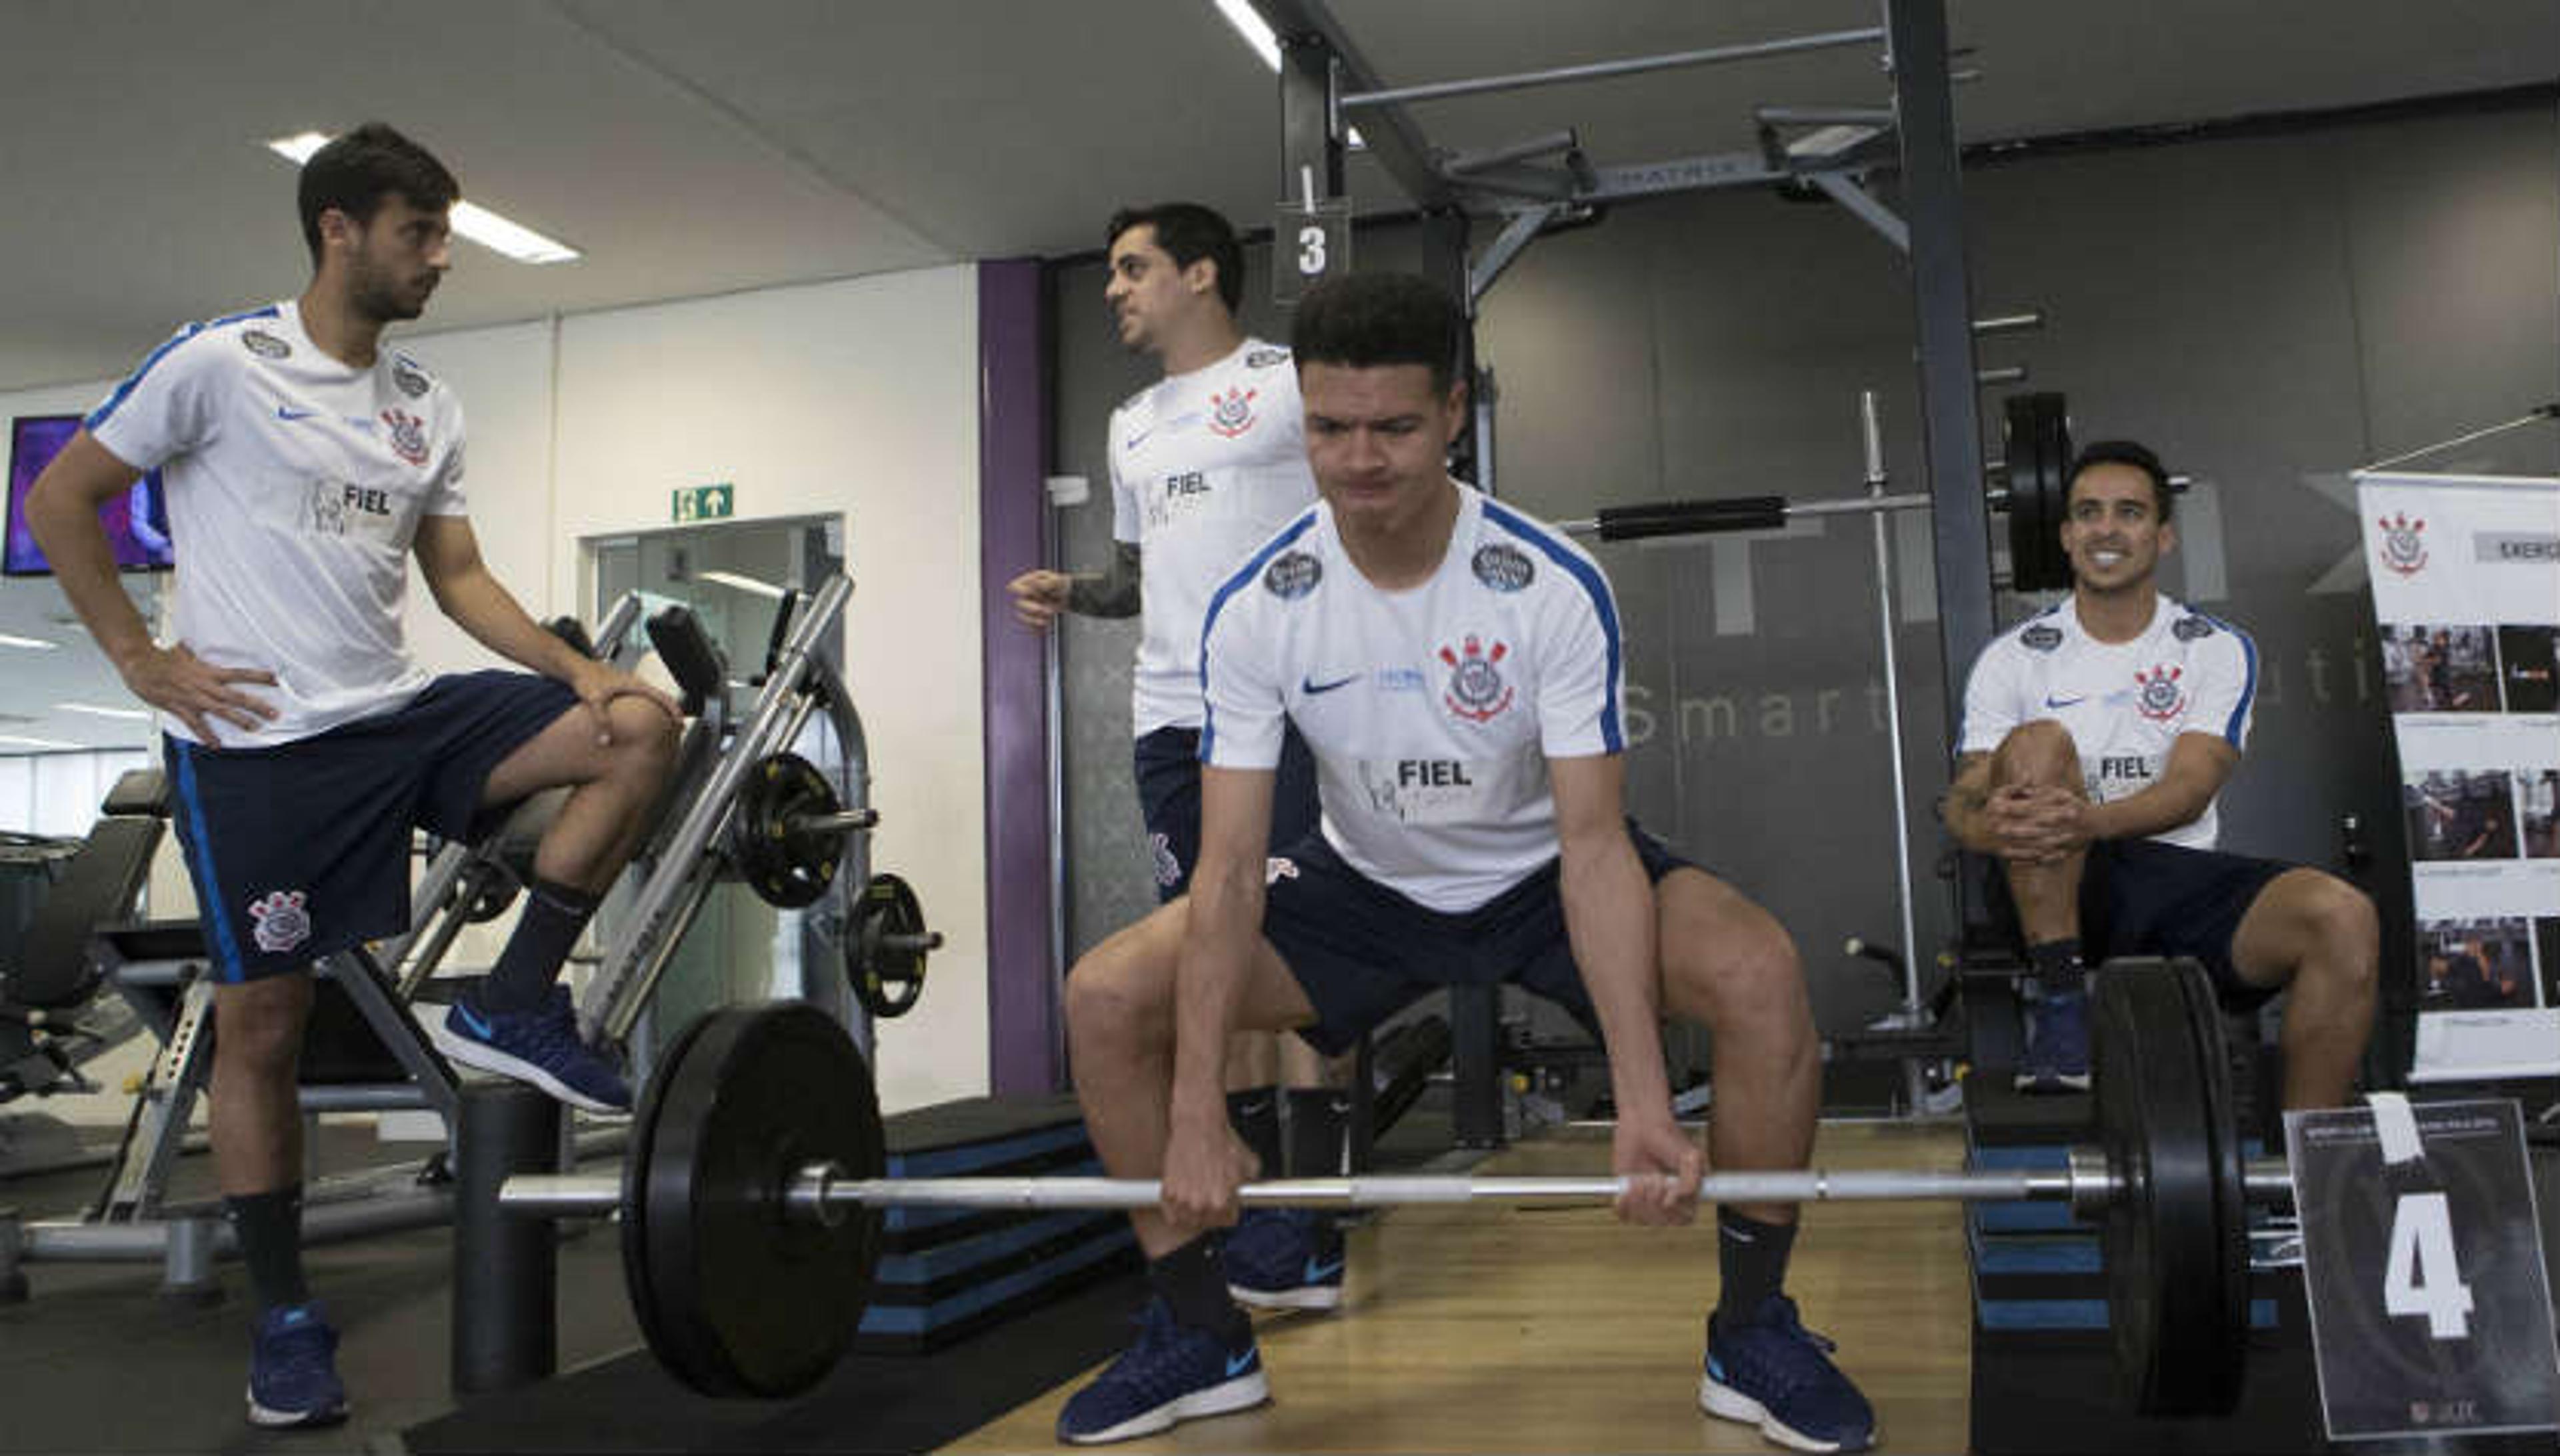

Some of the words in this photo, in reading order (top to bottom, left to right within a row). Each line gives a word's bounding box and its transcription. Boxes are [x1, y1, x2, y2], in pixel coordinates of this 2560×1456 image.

[1299, 226, 1325, 274] 3
[1167, 472, 1211, 497] FIEL
[343, 485, 391, 516] FIEL
[1623, 675, 1889, 741] Smart
[1399, 760, 1472, 787] FIEL
[2101, 756, 2151, 779] FIEL
[2385, 1192, 2475, 1339] 4
